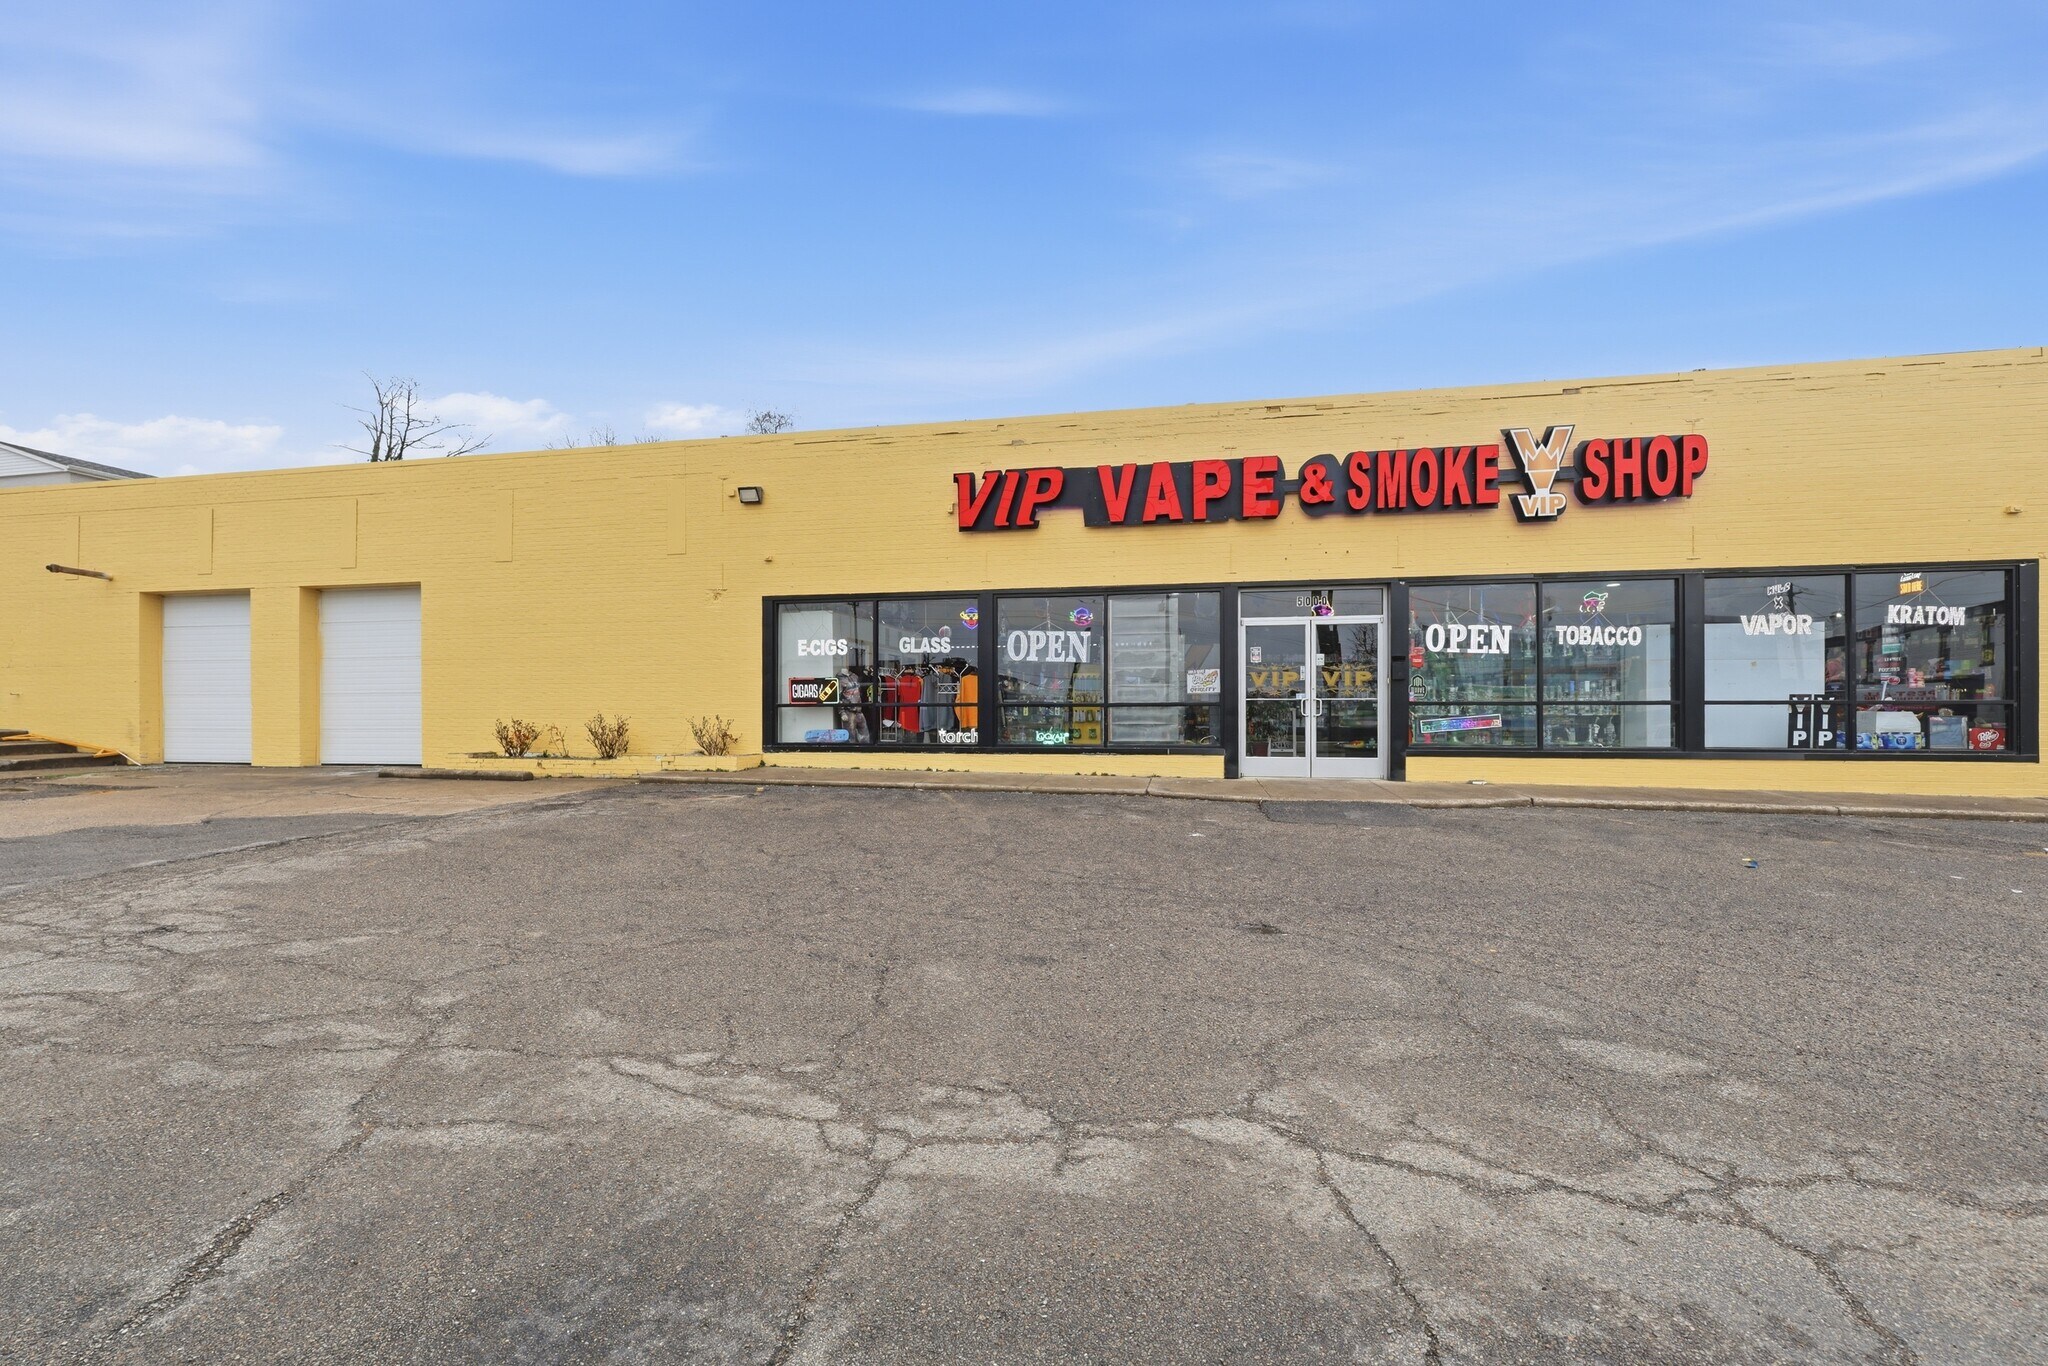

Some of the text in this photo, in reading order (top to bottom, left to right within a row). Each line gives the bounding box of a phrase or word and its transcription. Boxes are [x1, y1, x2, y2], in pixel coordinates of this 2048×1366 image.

[955, 434, 1708, 527] VIP VAPE & SMOKE SHOP
[1517, 493, 1567, 516] VIP
[1740, 614, 1813, 635] VAPOR
[1887, 604, 1966, 626] KRATOM
[899, 637, 951, 653] GLASS
[1007, 630, 1092, 662] OPEN
[1425, 624, 1512, 654] OPEN
[1556, 625, 1642, 646] TOBACCO
[1250, 671, 1300, 687] VIP
[1321, 671, 1373, 687] VIP
[792, 683, 818, 698] CIGARS
[1792, 697, 1807, 746] VIP
[1817, 697, 1833, 746] VIP
[938, 728, 978, 743] torch
